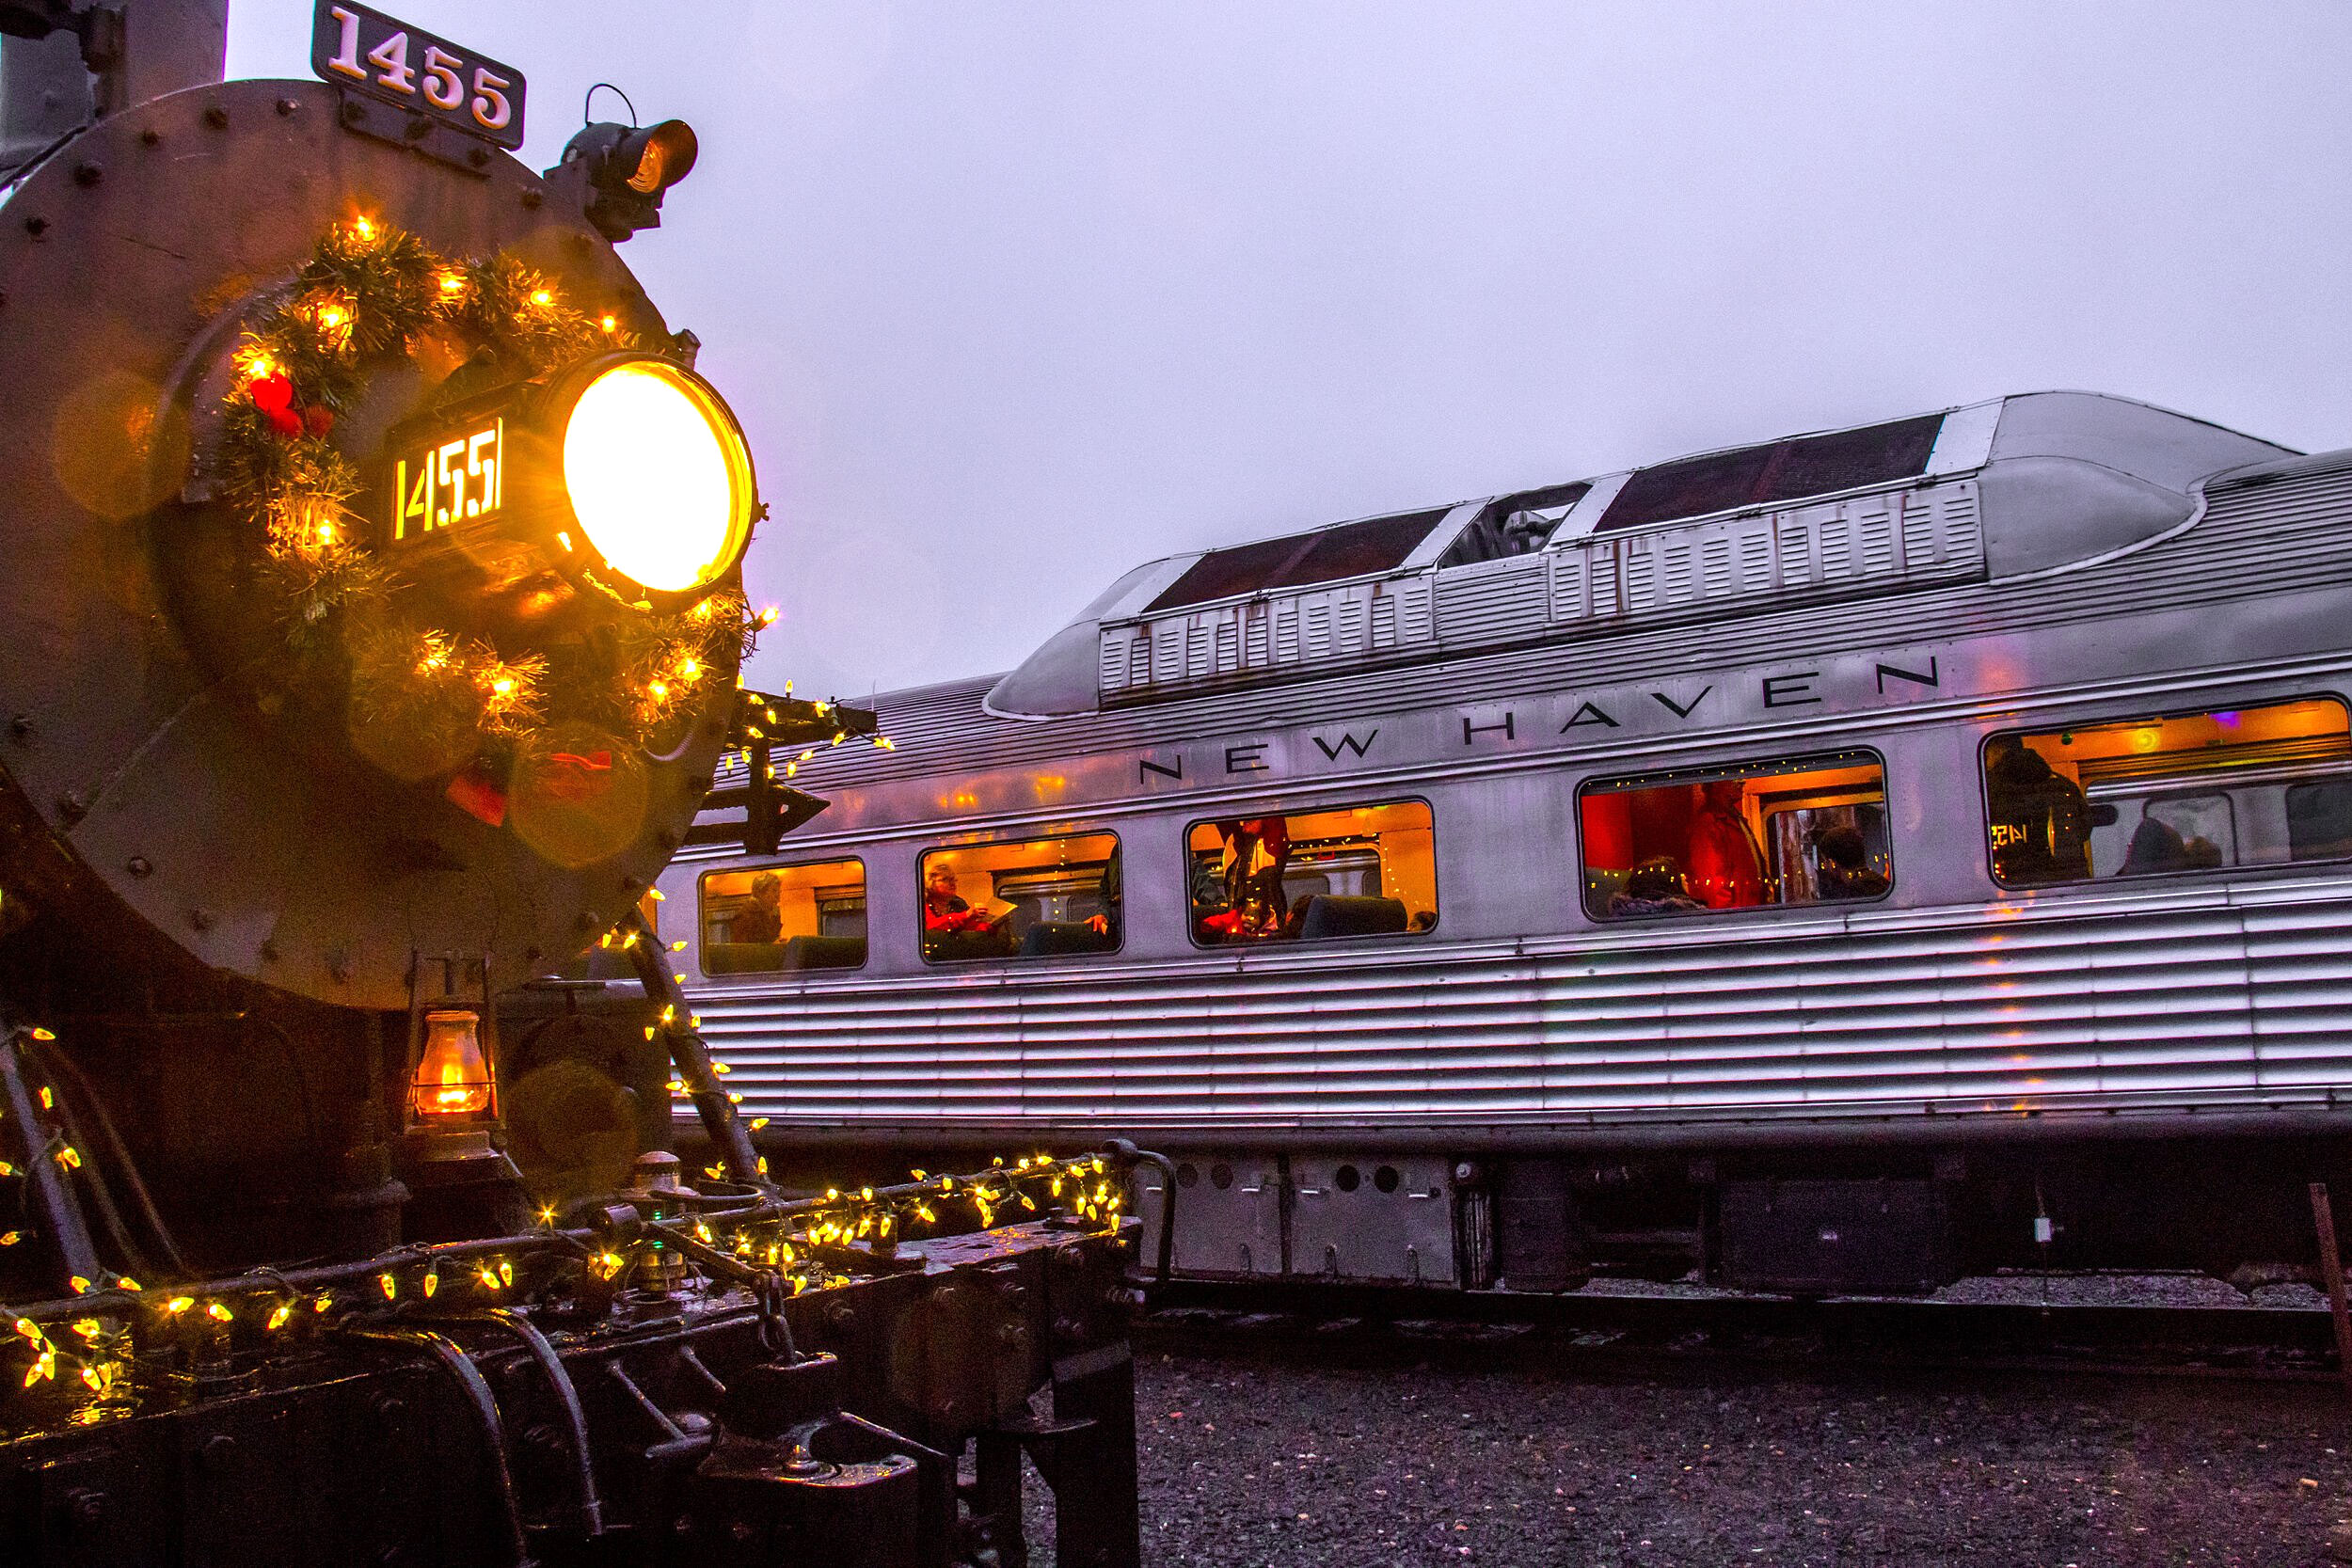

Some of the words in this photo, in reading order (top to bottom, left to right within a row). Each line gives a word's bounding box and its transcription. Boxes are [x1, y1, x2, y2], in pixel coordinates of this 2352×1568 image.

[329, 6, 512, 130] 1455
[1139, 729, 1379, 784] NEW
[1463, 656, 1939, 745] HAVEN
